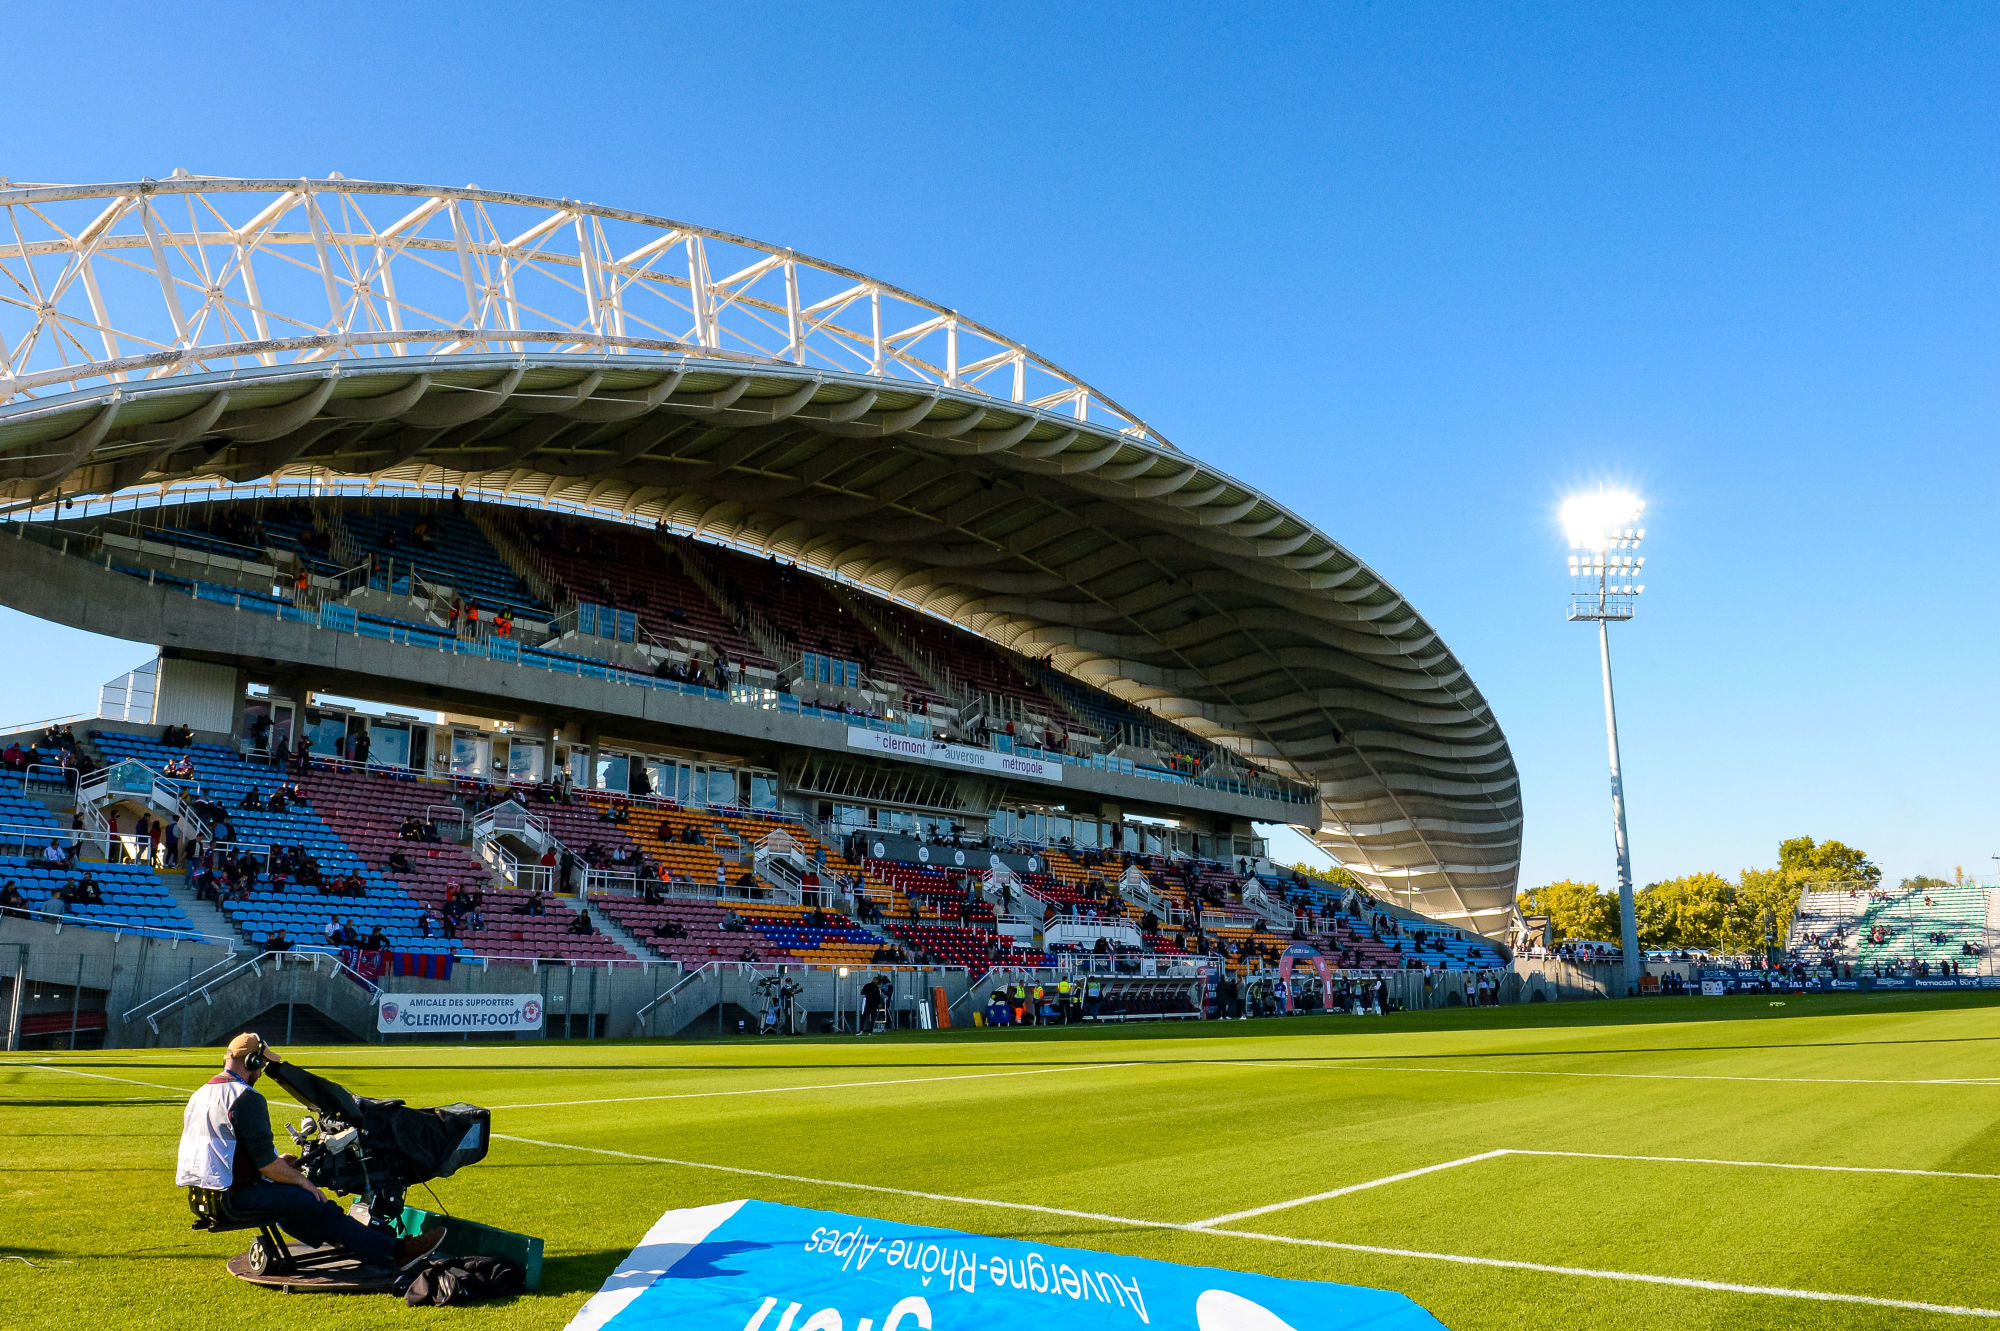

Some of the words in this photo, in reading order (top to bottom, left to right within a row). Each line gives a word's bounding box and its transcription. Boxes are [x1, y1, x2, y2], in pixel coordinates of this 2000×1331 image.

[882, 735, 926, 755] clermont
[944, 748, 985, 765] auvergne
[1002, 758, 1043, 775] métropole
[409, 999, 446, 1007] AMICALE
[449, 999, 464, 1007] DES
[465, 998, 514, 1007] SUPPORTERS
[405, 1013, 514, 1027] CLERMONT-FOOT
[804, 1226, 1150, 1324] Auvergne-Rhône-Alpes
